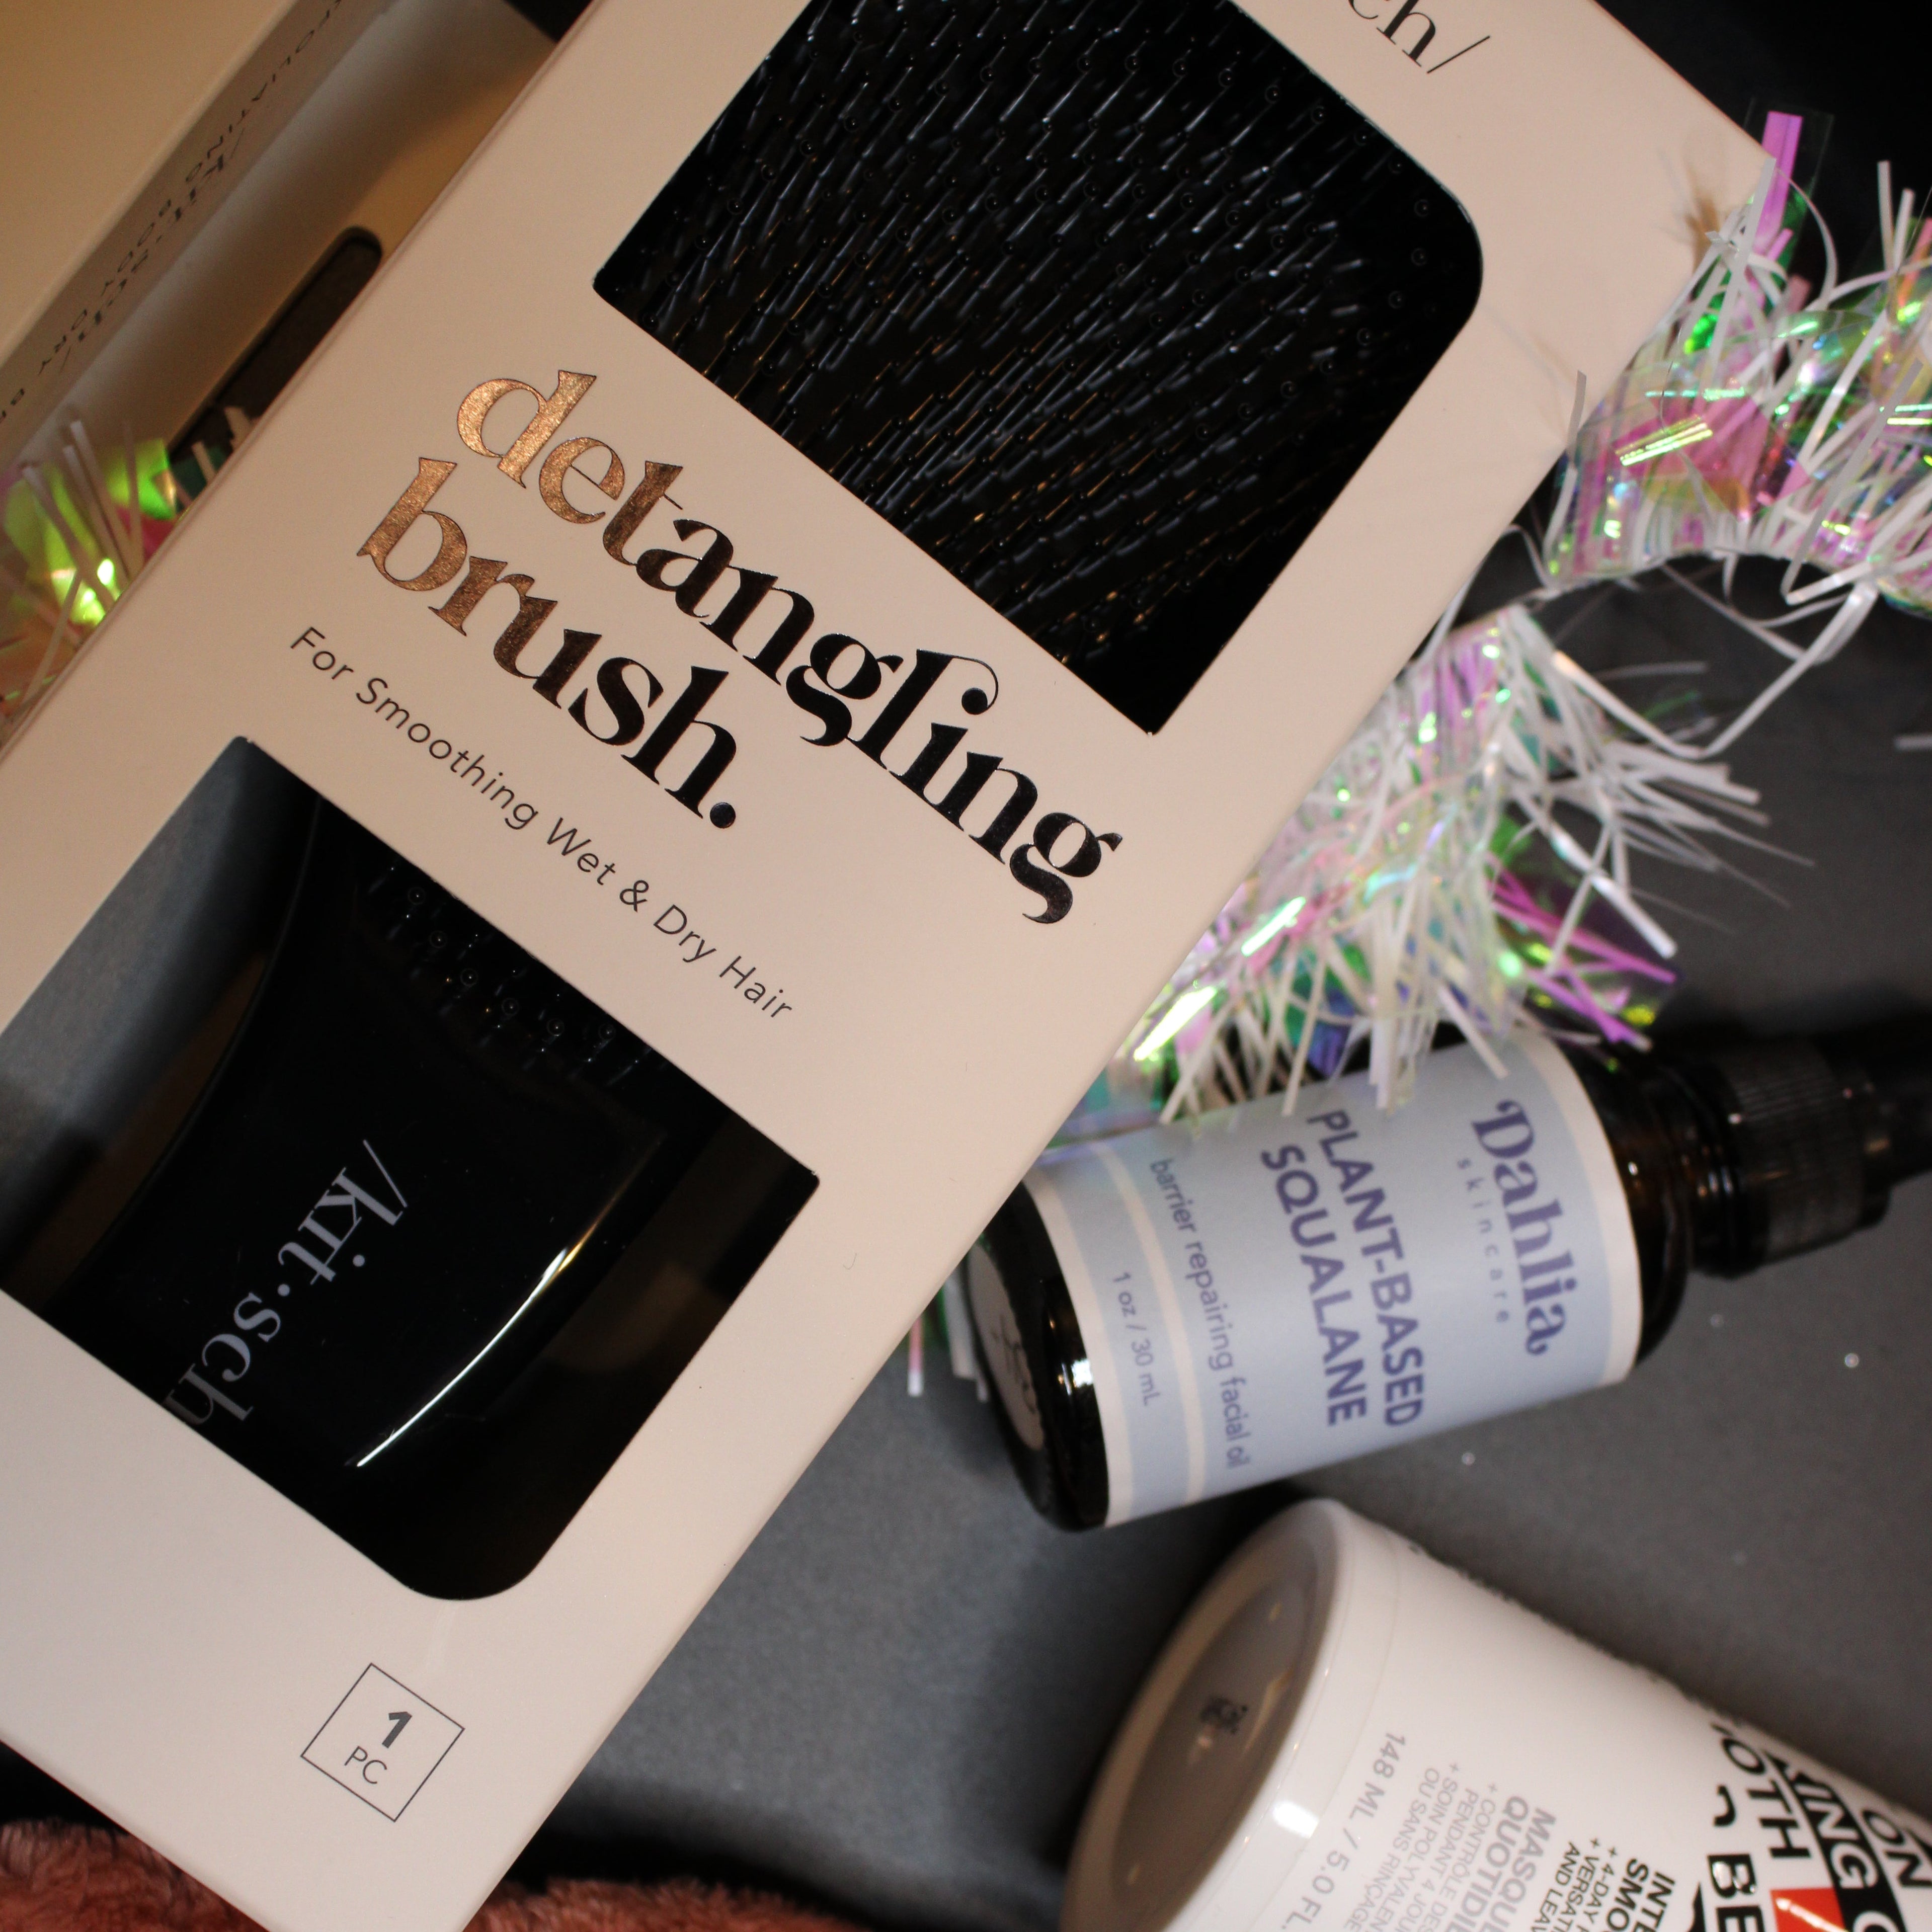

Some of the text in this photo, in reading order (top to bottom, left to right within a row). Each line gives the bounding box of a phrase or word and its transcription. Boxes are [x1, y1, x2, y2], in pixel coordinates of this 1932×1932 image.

[357, 457, 737, 829] brush.
[457, 370, 1123, 924] detangling
[290, 626, 792, 1018] For Smoothing Wet & Dry Hair
[1458, 1158, 1509, 1323] skincare
[1471, 1099, 1578, 1356] Dahlia
[1113, 1271, 1131, 1283] 1
[1261, 1145, 1367, 1426] SQUALANE
[1307, 1109, 1424, 1426] PLANT-BASED
[1118, 1291, 1137, 1318] oz
[1150, 1158, 1250, 1469] barrier repairing facial oil
[1131, 1339, 1154, 1367] 30
[1139, 1373, 1161, 1406] mL
[382, 1711, 413, 1748] 1
[344, 1745, 387, 1784] PC
[1373, 1732, 1406, 1779] 148
[1349, 1782, 1385, 1820] ML
[1418, 1767, 1439, 1799] OU
[1429, 1777, 1458, 1825] SOIN
[1711, 1723, 1812, 1859] OTH
[1343, 1827, 1358, 1850] /
[1392, 1799, 1427, 1852] SANS
[1312, 1850, 1350, 1894] 5.0
[1395, 1788, 1479, 1932] PENDANT 4 JOU
[1555, 1841, 1580, 1886] AND
[1583, 1863, 1615, 1924] 4-DAY
